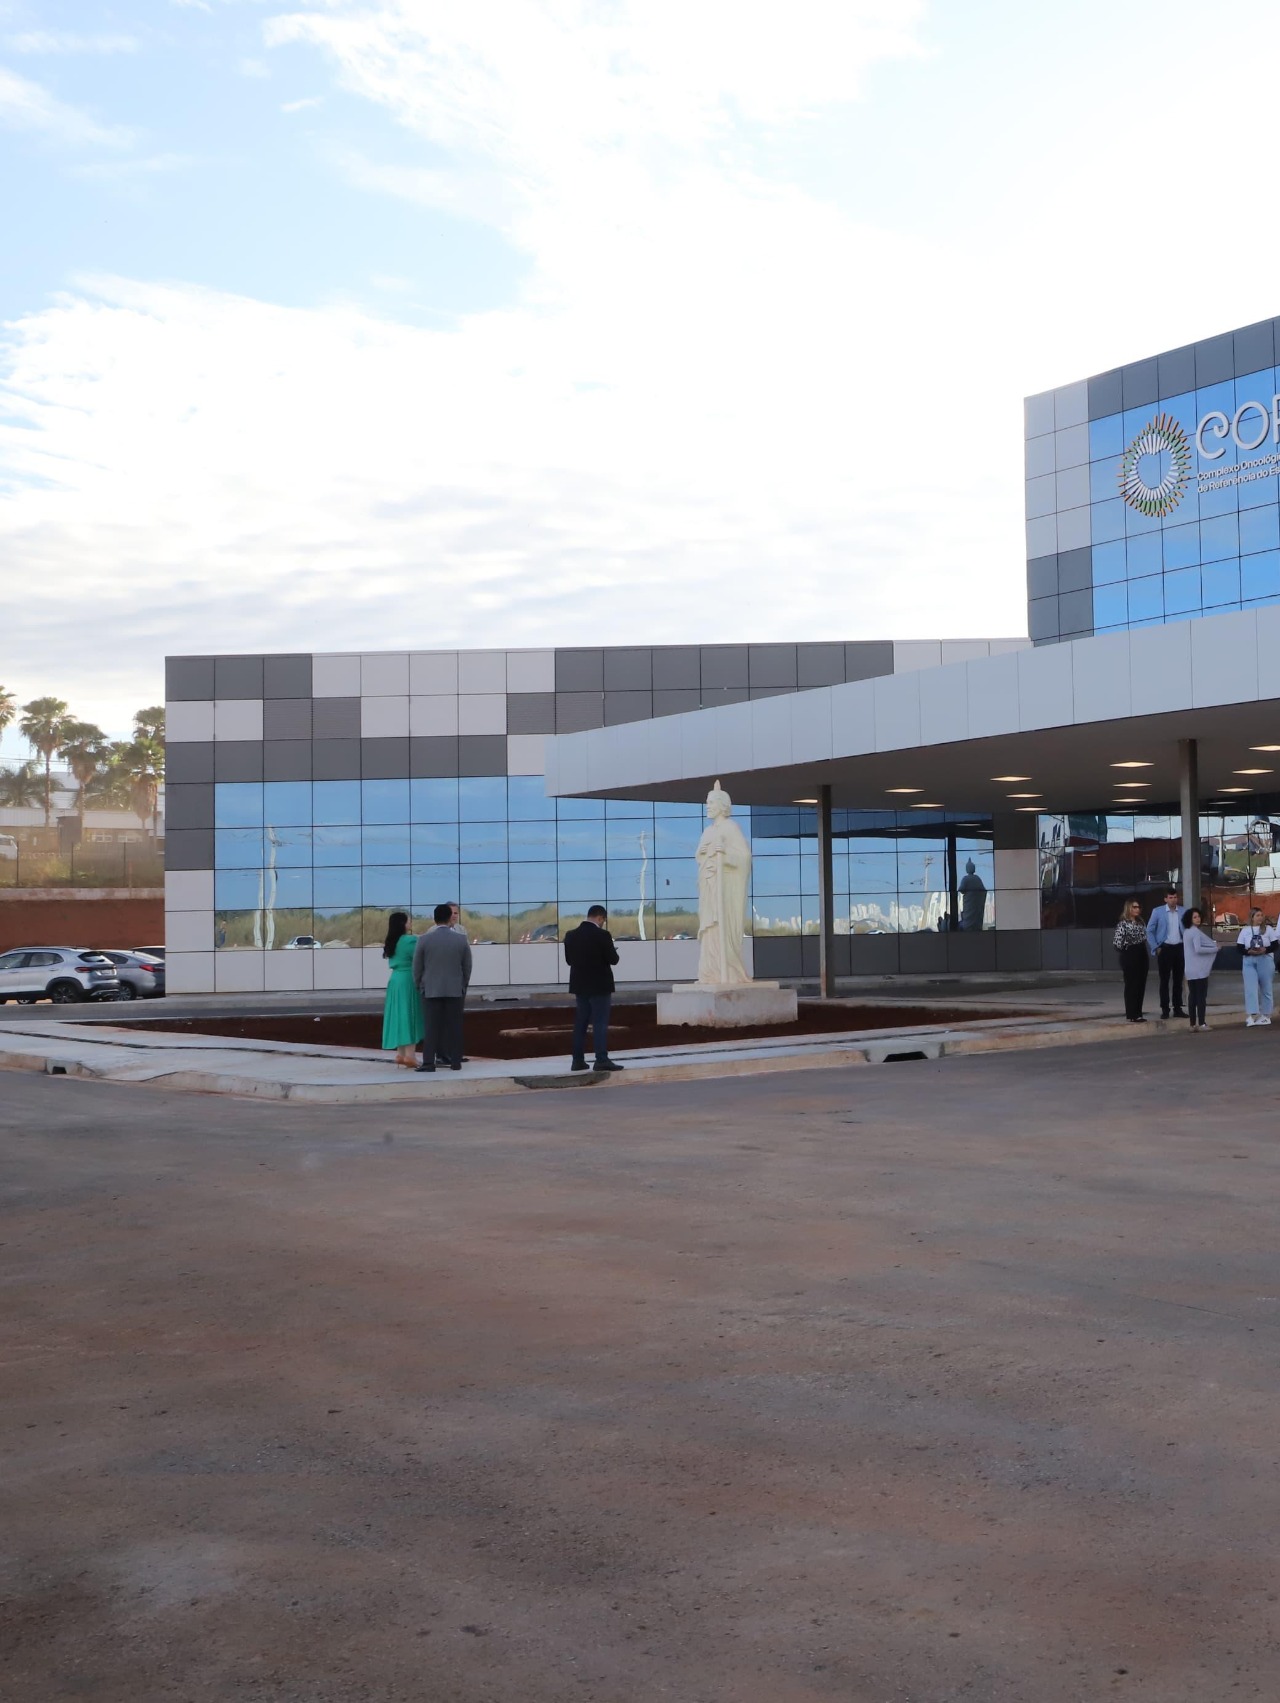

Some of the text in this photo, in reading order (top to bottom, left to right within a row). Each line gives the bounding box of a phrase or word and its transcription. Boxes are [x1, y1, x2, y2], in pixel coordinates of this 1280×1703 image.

[1197, 463, 1240, 481] Complexo
[1197, 483, 1209, 493] de
[1256, 469, 1269, 479] do
